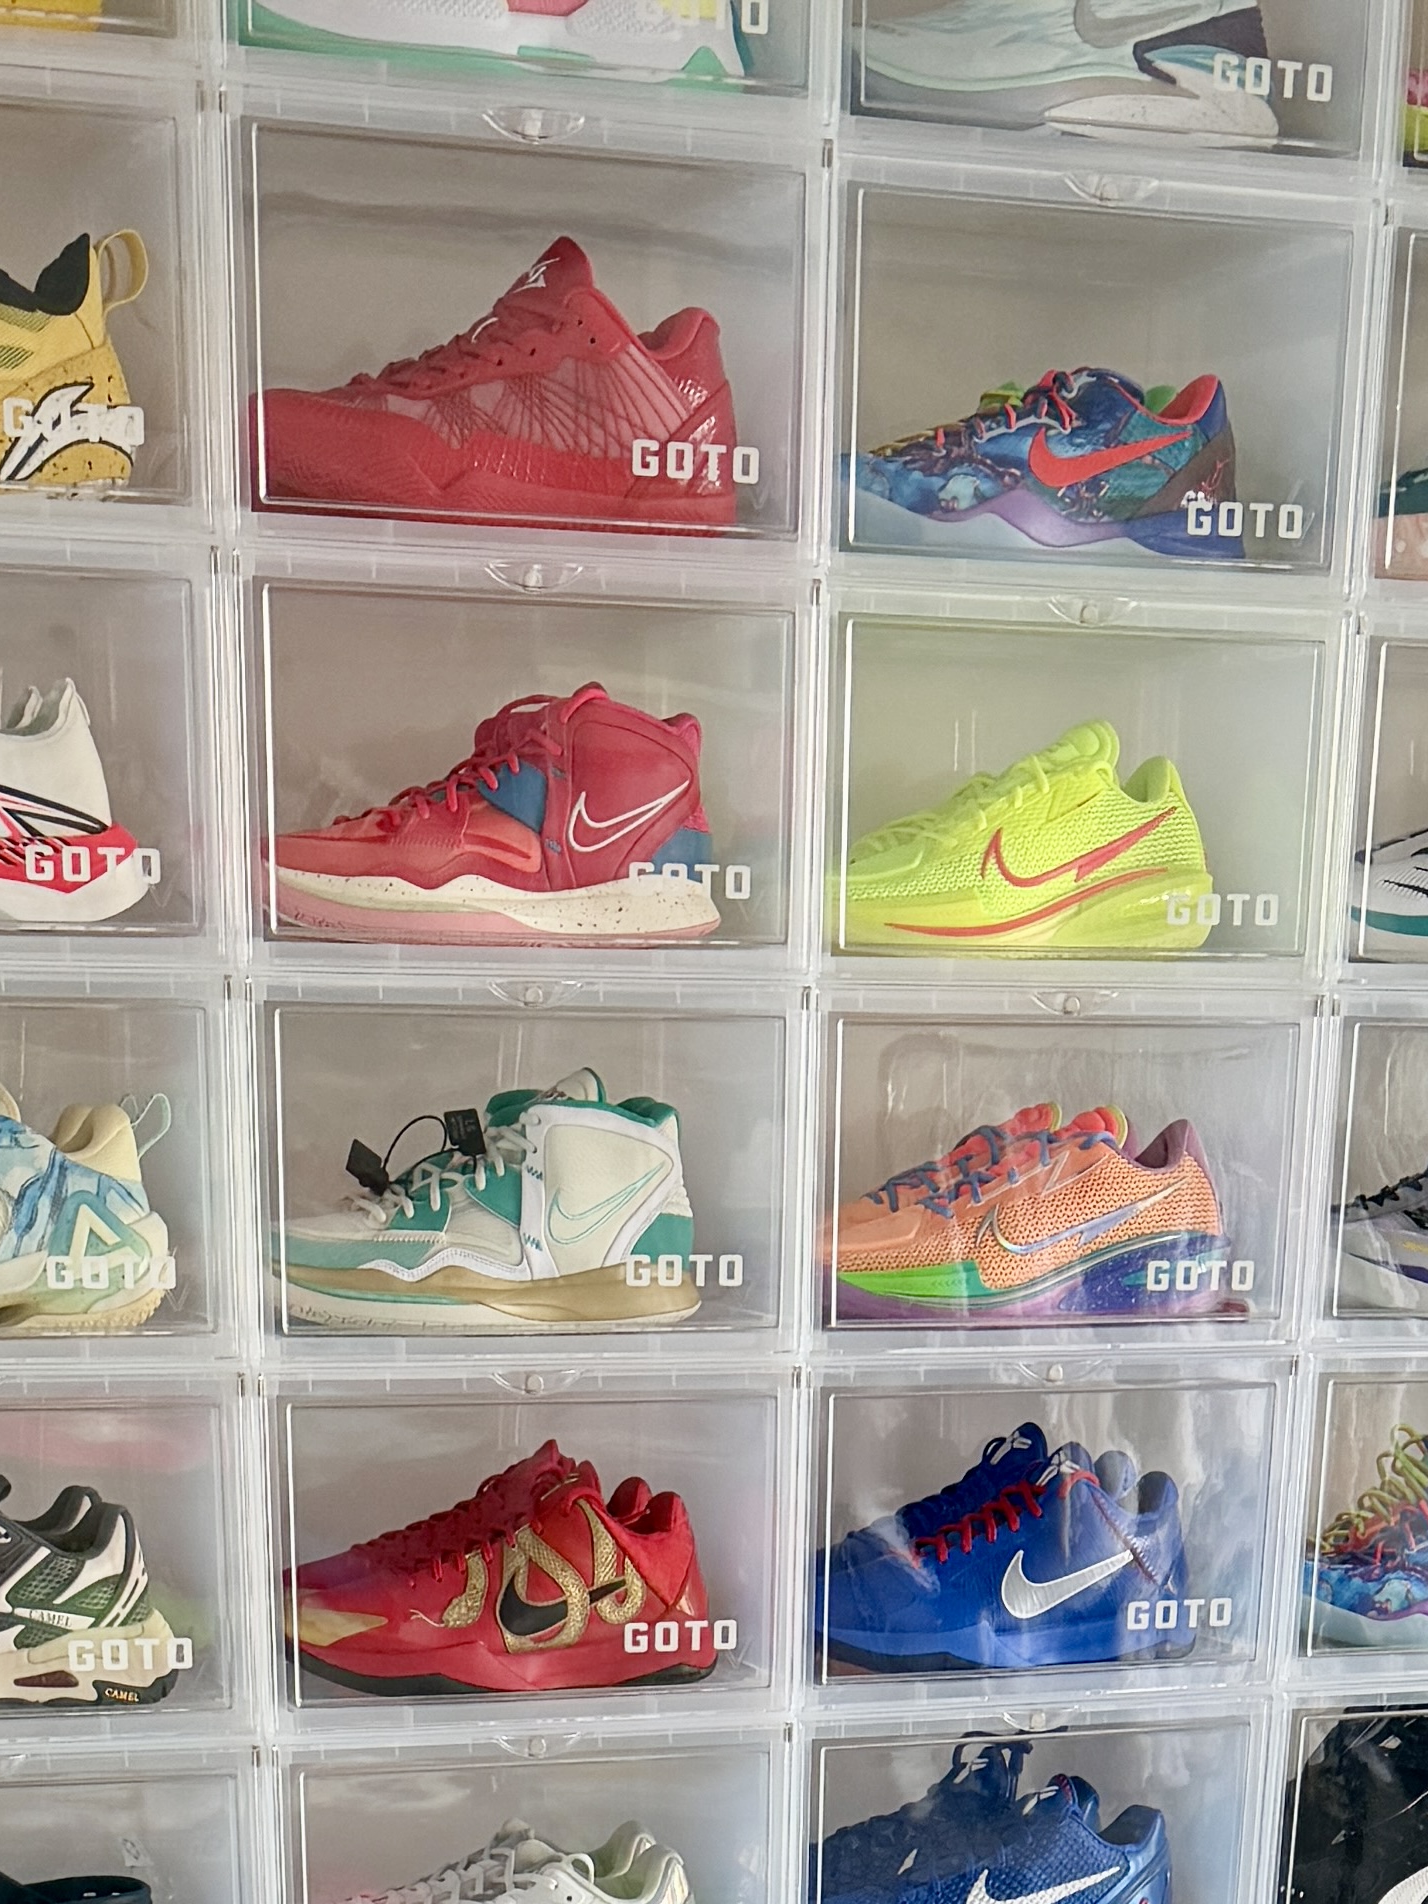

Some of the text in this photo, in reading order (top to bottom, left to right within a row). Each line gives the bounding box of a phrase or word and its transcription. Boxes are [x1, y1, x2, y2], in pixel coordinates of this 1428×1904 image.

[1213, 53, 1334, 102] GOTO
[632, 439, 760, 486] GOTO
[1187, 501, 1302, 539] GOTO
[24, 846, 161, 886] GOTO
[1167, 894, 1279, 928] GOTO
[45, 1255, 176, 1290] GOTO
[625, 1255, 744, 1288] GOTO
[1147, 1260, 1254, 1292] GOTO
[28, 1610, 73, 1628] CAMEL
[1126, 1598, 1233, 1630] GOTO
[622, 1622, 736, 1653] GOTO
[69, 1638, 194, 1671] GOTO
[105, 1687, 140, 1703] CAMEL
